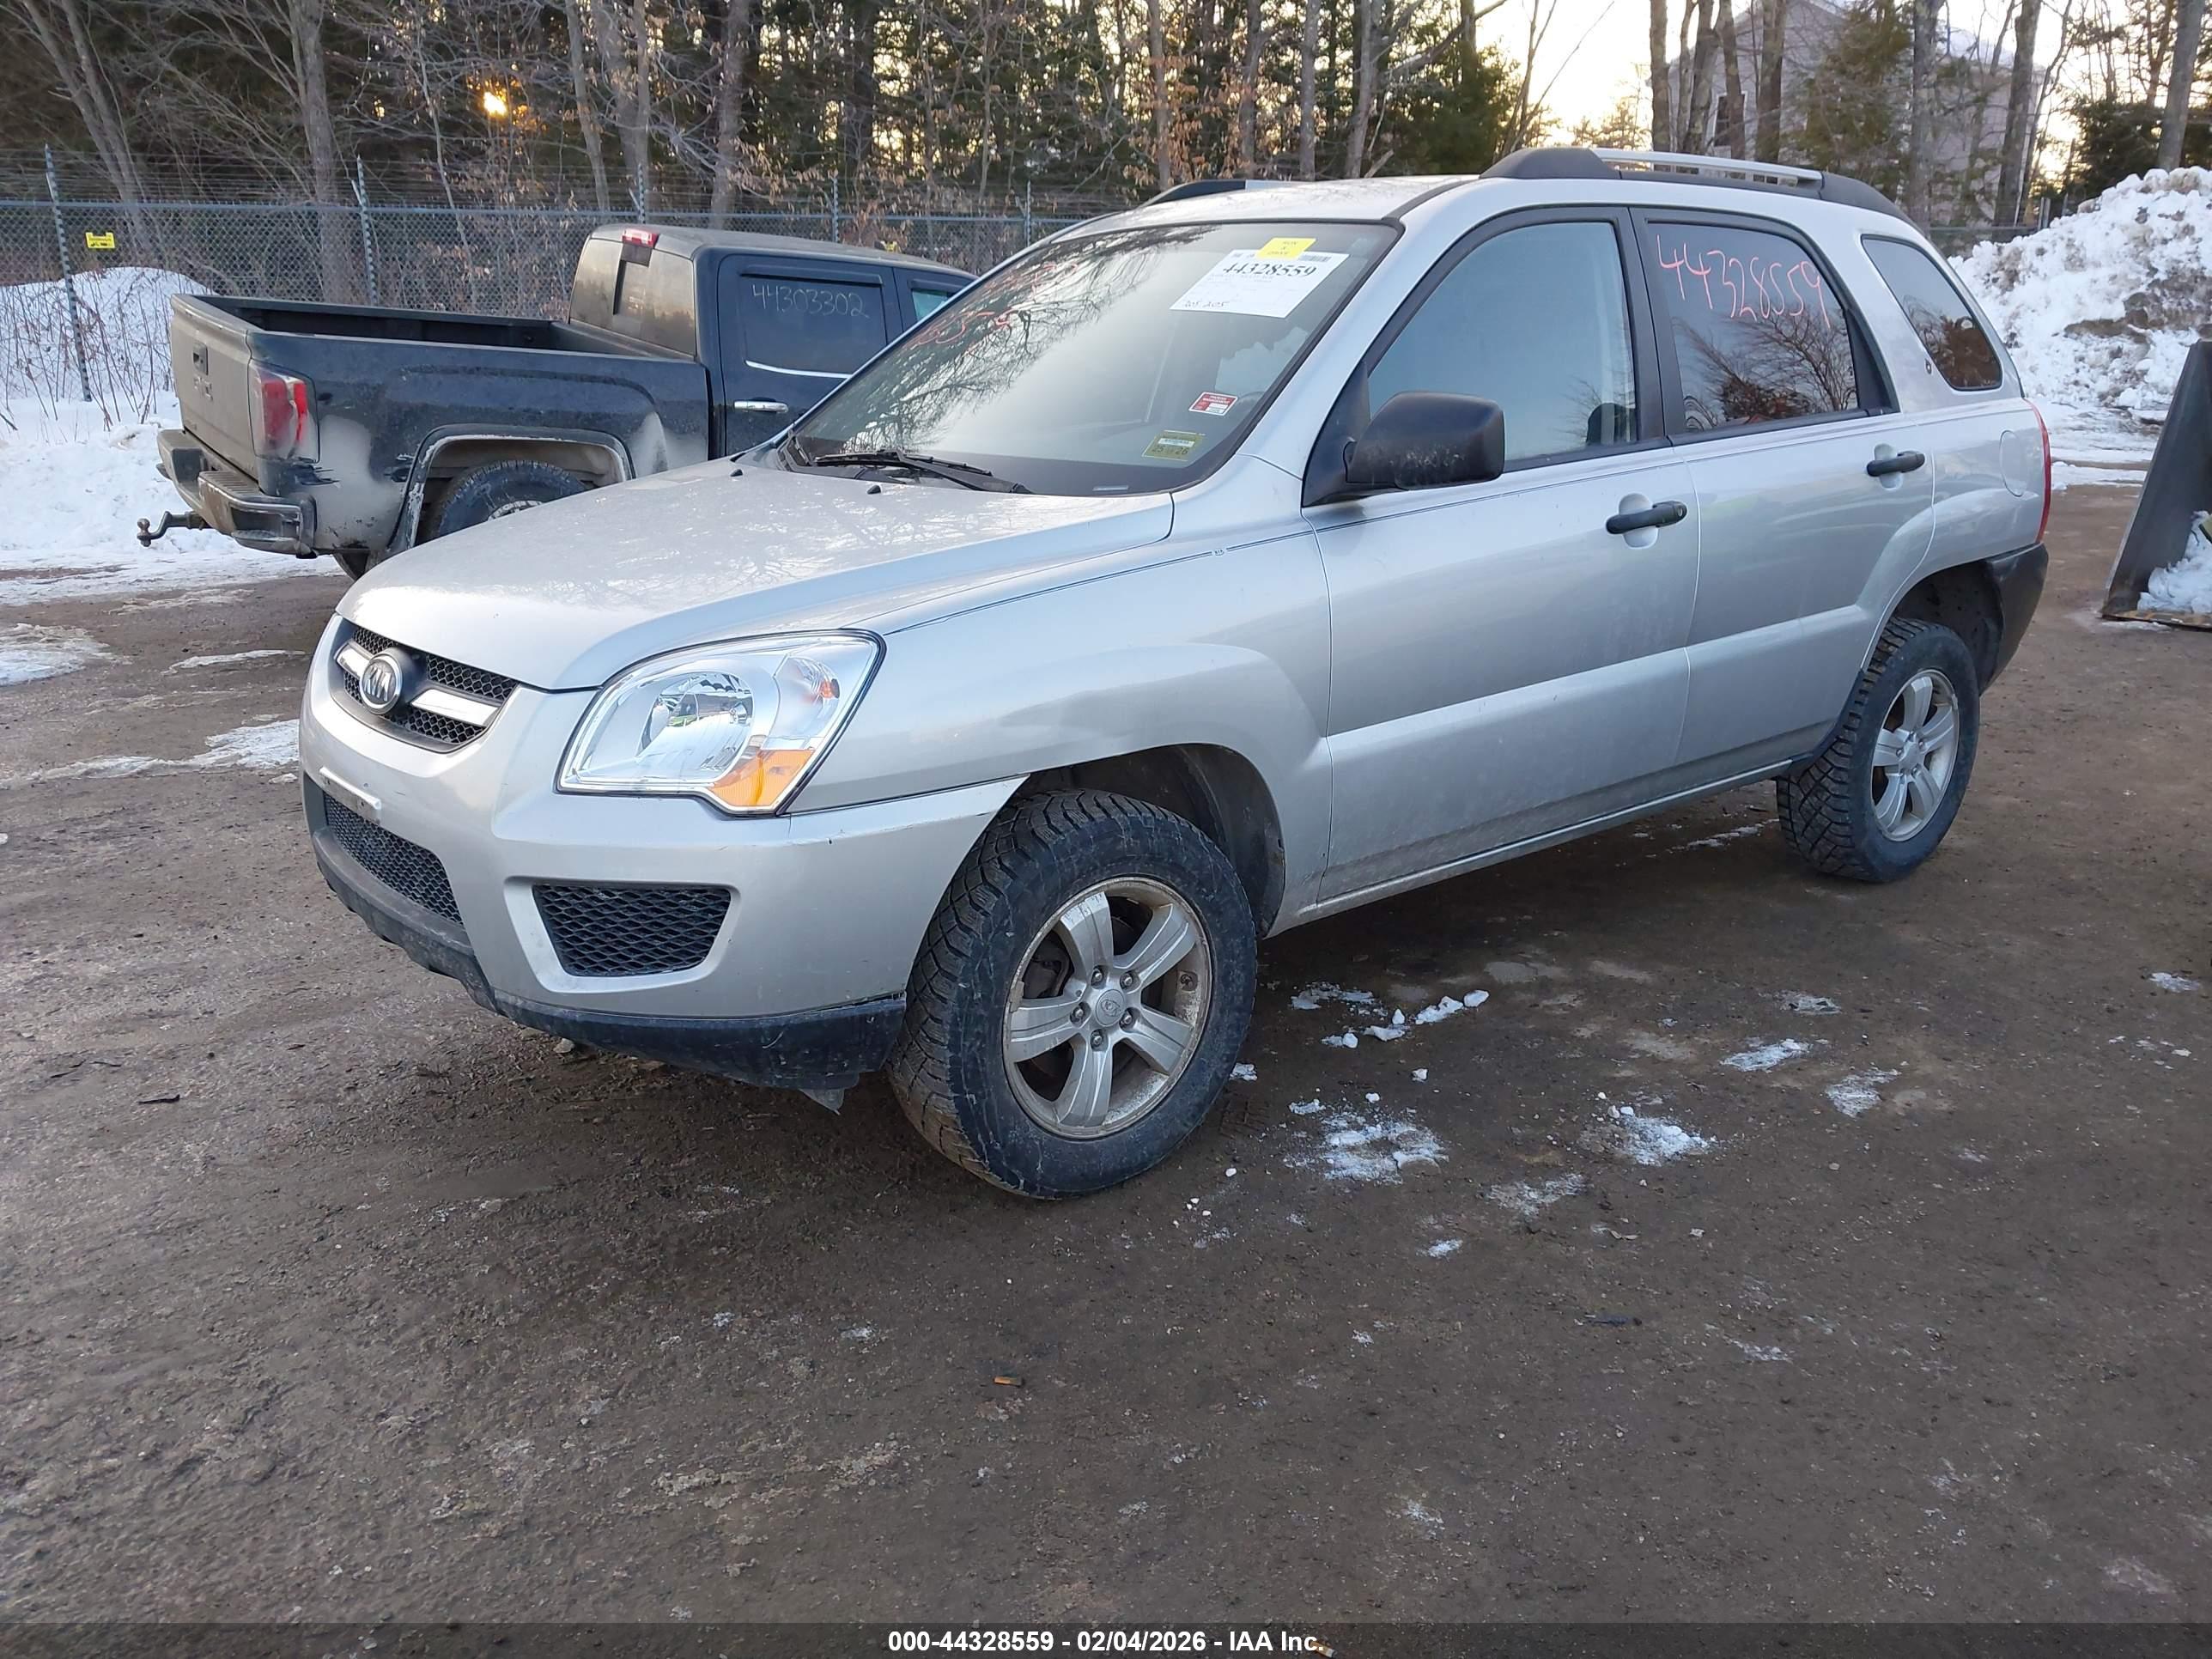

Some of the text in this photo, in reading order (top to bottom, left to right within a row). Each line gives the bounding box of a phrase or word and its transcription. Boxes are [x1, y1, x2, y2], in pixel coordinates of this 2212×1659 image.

[1223, 262, 1317, 277] 44328559
[1656, 234, 1831, 330] 44328559
[751, 283, 871, 319] 44303302
